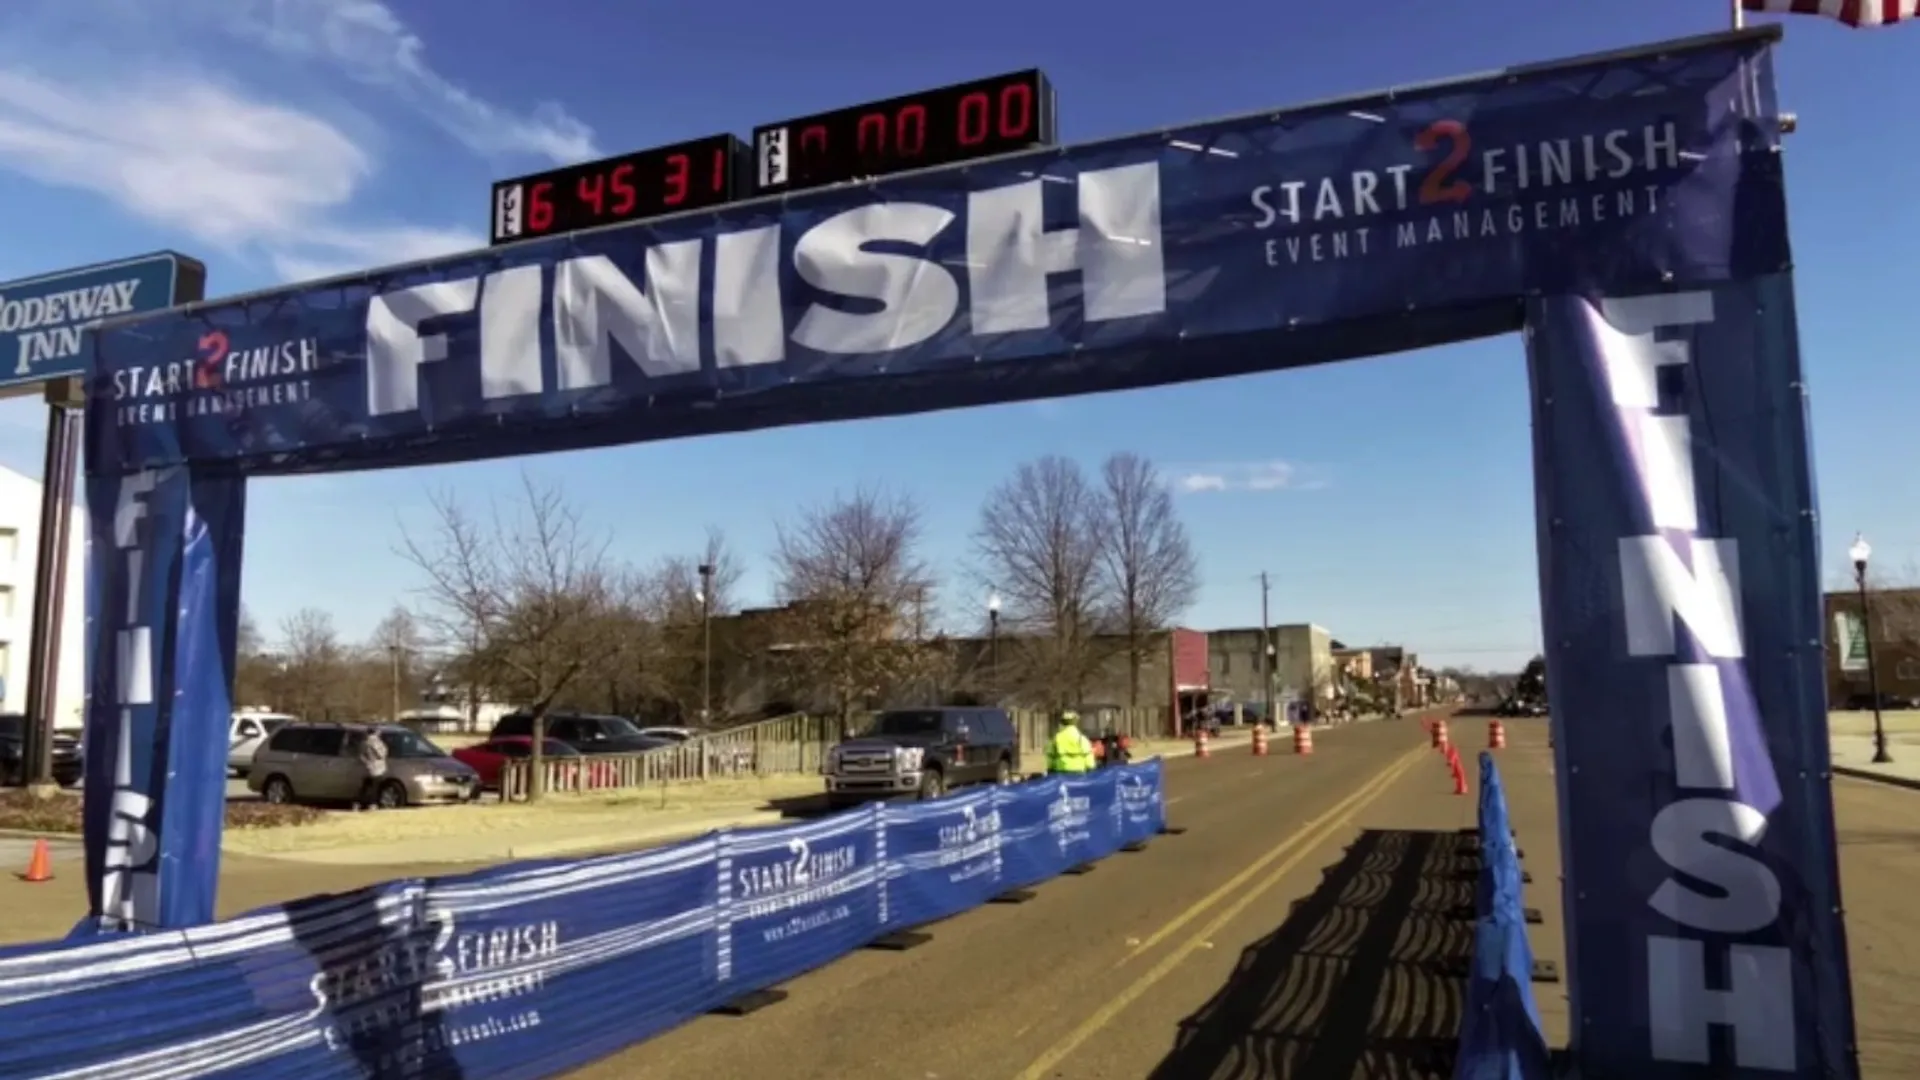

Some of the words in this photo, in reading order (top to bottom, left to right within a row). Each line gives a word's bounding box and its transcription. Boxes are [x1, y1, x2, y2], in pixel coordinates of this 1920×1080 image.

[959, 83, 1032, 145] 00
[529, 183, 554, 231] 6
[577, 164, 637, 217] 45
[664, 149, 724, 206] 31
[1265, 227, 1371, 267] EVENT
[1396, 185, 1660, 249] MANAGEMENT
[0, 279, 141, 332] ODEWAY
[366, 160, 1167, 418] FINISH
[14, 323, 83, 374] INN
[1602, 289, 1798, 1073] FINISH
